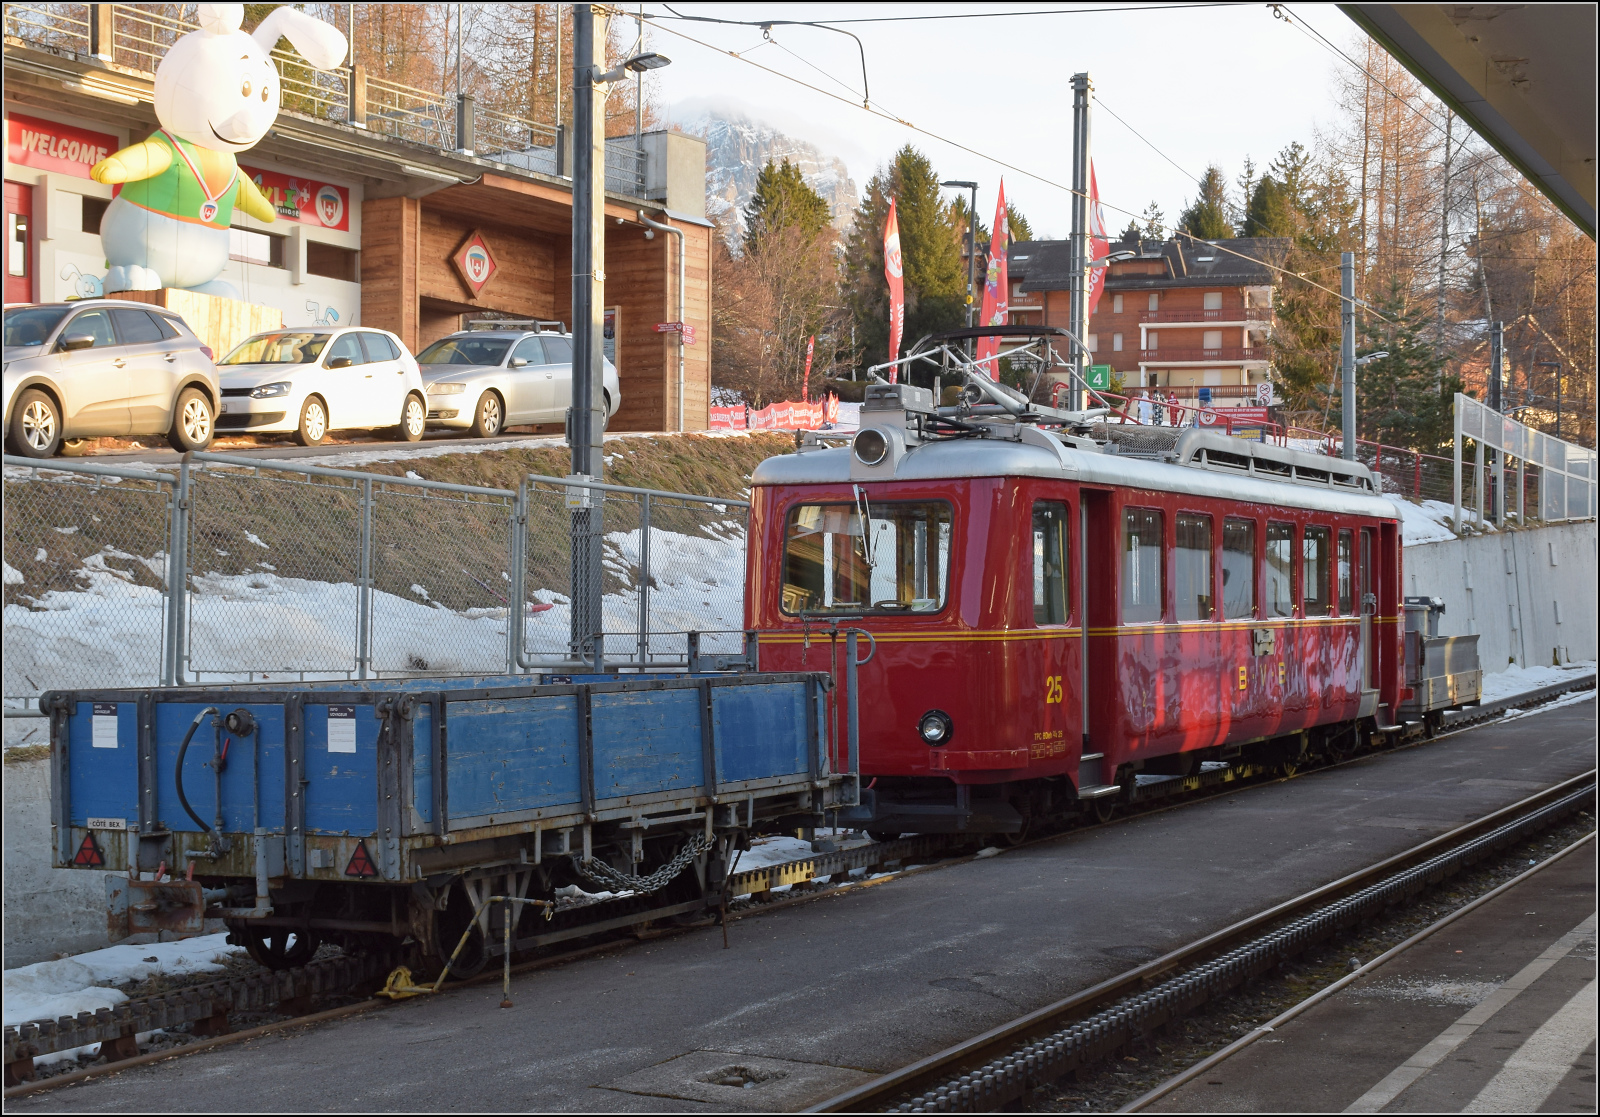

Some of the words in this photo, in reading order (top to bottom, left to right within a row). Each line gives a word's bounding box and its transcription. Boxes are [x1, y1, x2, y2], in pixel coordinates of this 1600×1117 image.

[21, 129, 108, 166] WELCOME
[1092, 373, 1103, 386] 4
[1046, 675, 1063, 704] 25
[92, 819, 106, 828] CÔTÉ
